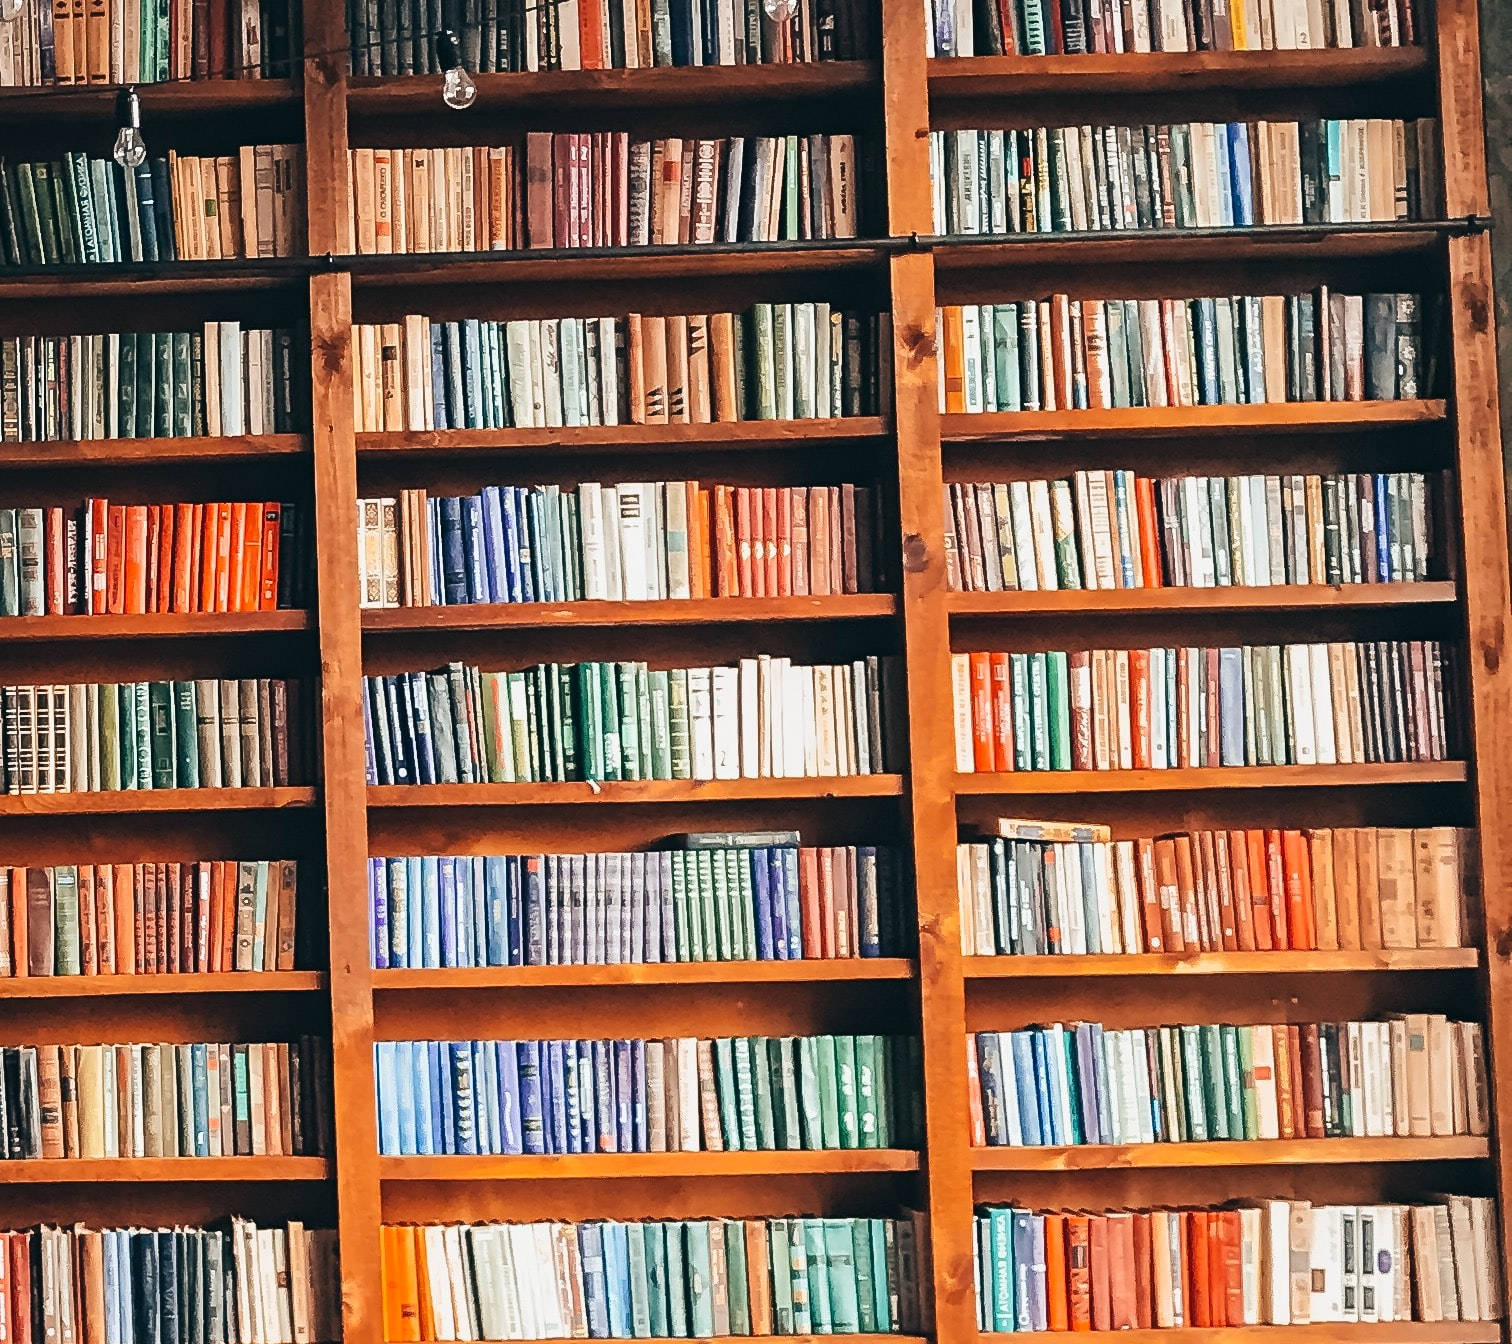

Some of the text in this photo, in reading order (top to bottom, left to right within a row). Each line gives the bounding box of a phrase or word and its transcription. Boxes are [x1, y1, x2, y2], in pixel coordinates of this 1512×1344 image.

[76, 155, 95, 249] АТОМНАЯ ФИЗИКА
[996, 1215, 1008, 1312] АТОМНАЯ ФИЗИКА
